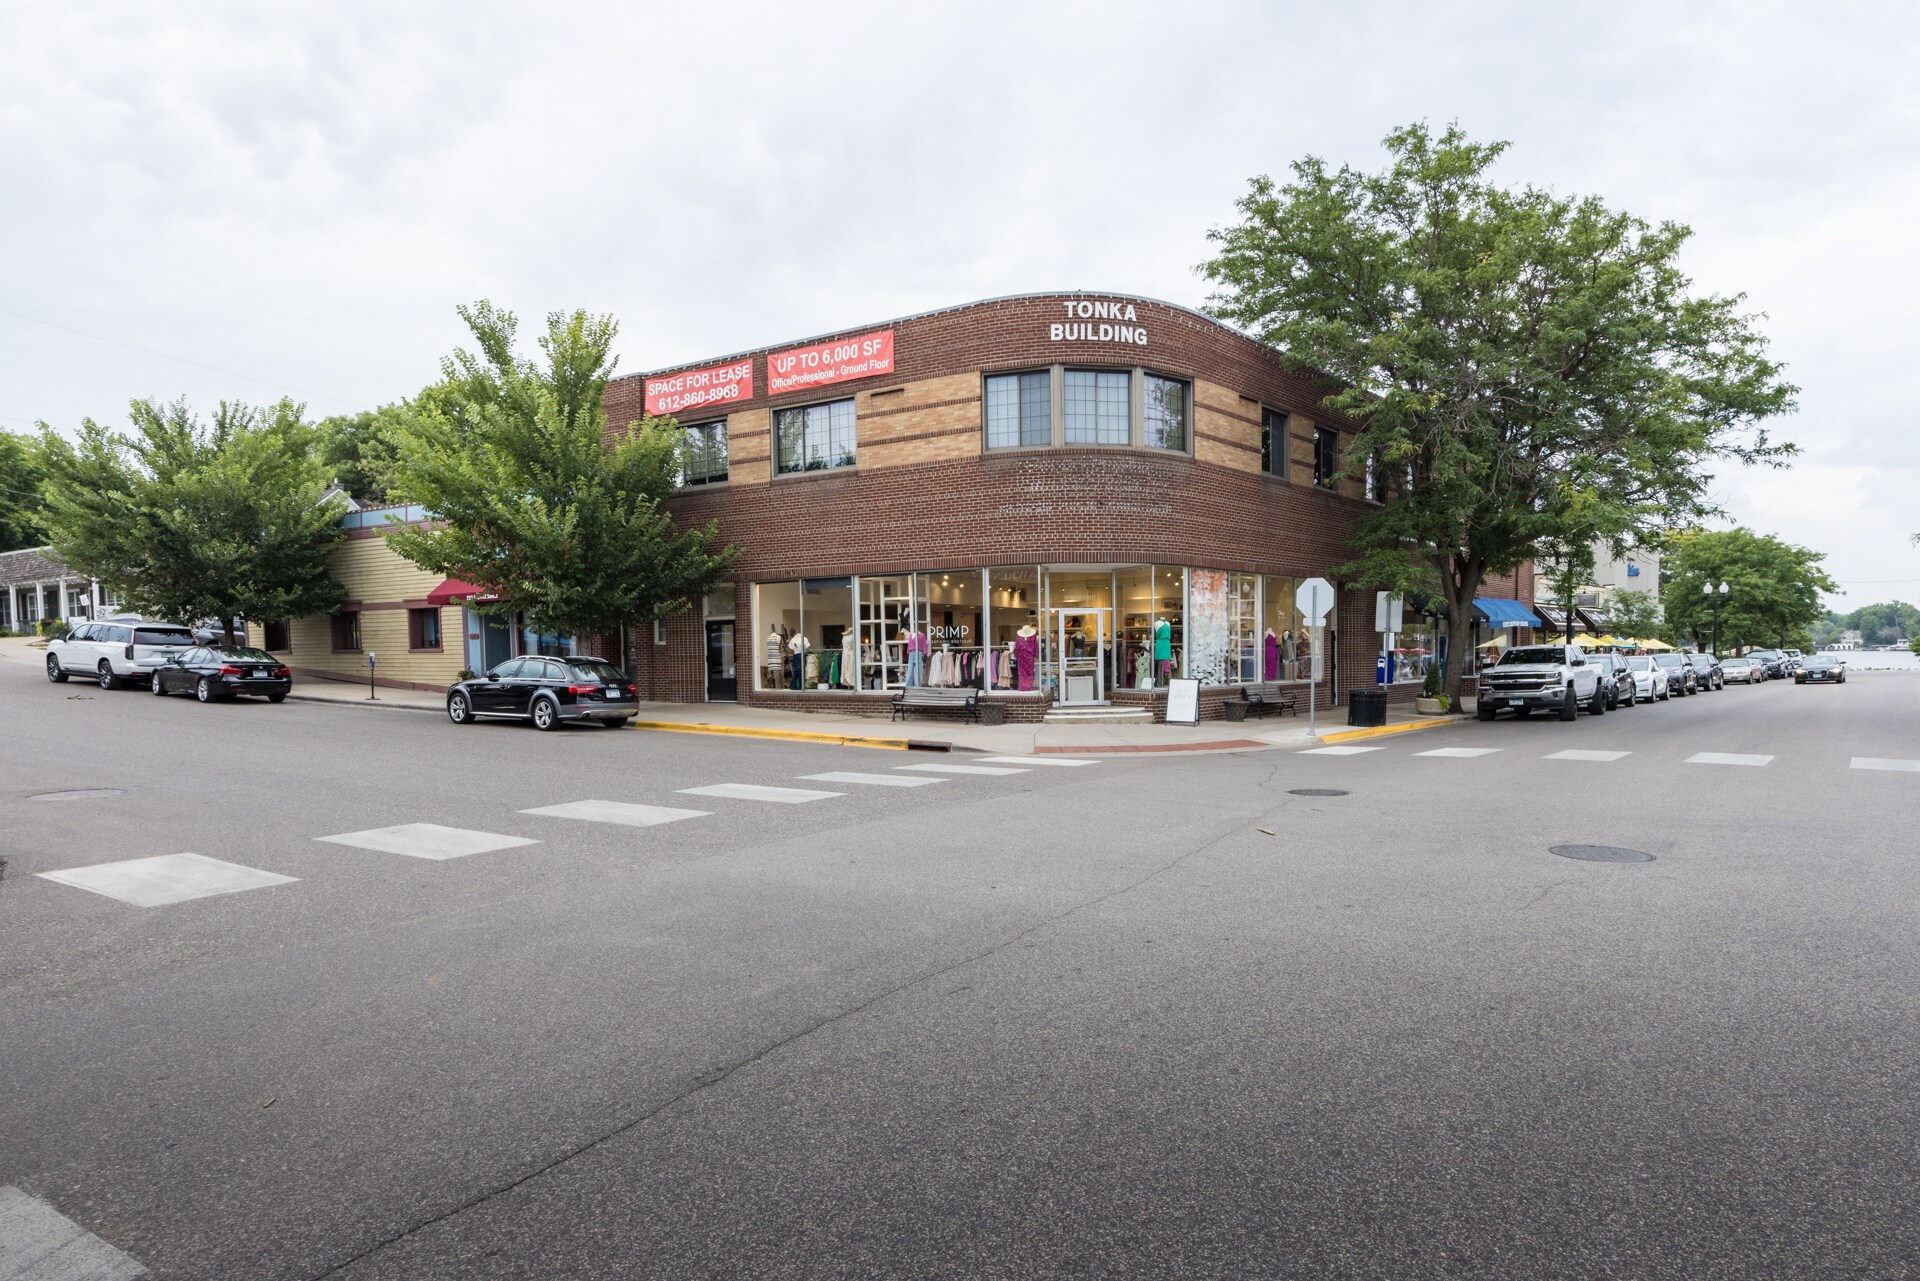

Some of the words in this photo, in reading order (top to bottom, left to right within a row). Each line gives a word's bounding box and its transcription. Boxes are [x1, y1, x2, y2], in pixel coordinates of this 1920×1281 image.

[1064, 301, 1136, 321] TONKA
[1050, 323, 1147, 345] BUILDING
[777, 356, 797, 373] UP
[799, 351, 820, 368] TO
[822, 343, 859, 366] 6,000
[863, 338, 882, 355] SF
[648, 378, 684, 396] SPACE
[686, 373, 710, 388] FOR
[712, 365, 750, 384] LEASE
[771, 368, 835, 390] Office/Professional
[841, 361, 868, 376] Ground
[869, 358, 889, 370] Floor
[658, 384, 739, 411] 612-860-8968
[929, 625, 969, 639] PRIMP
